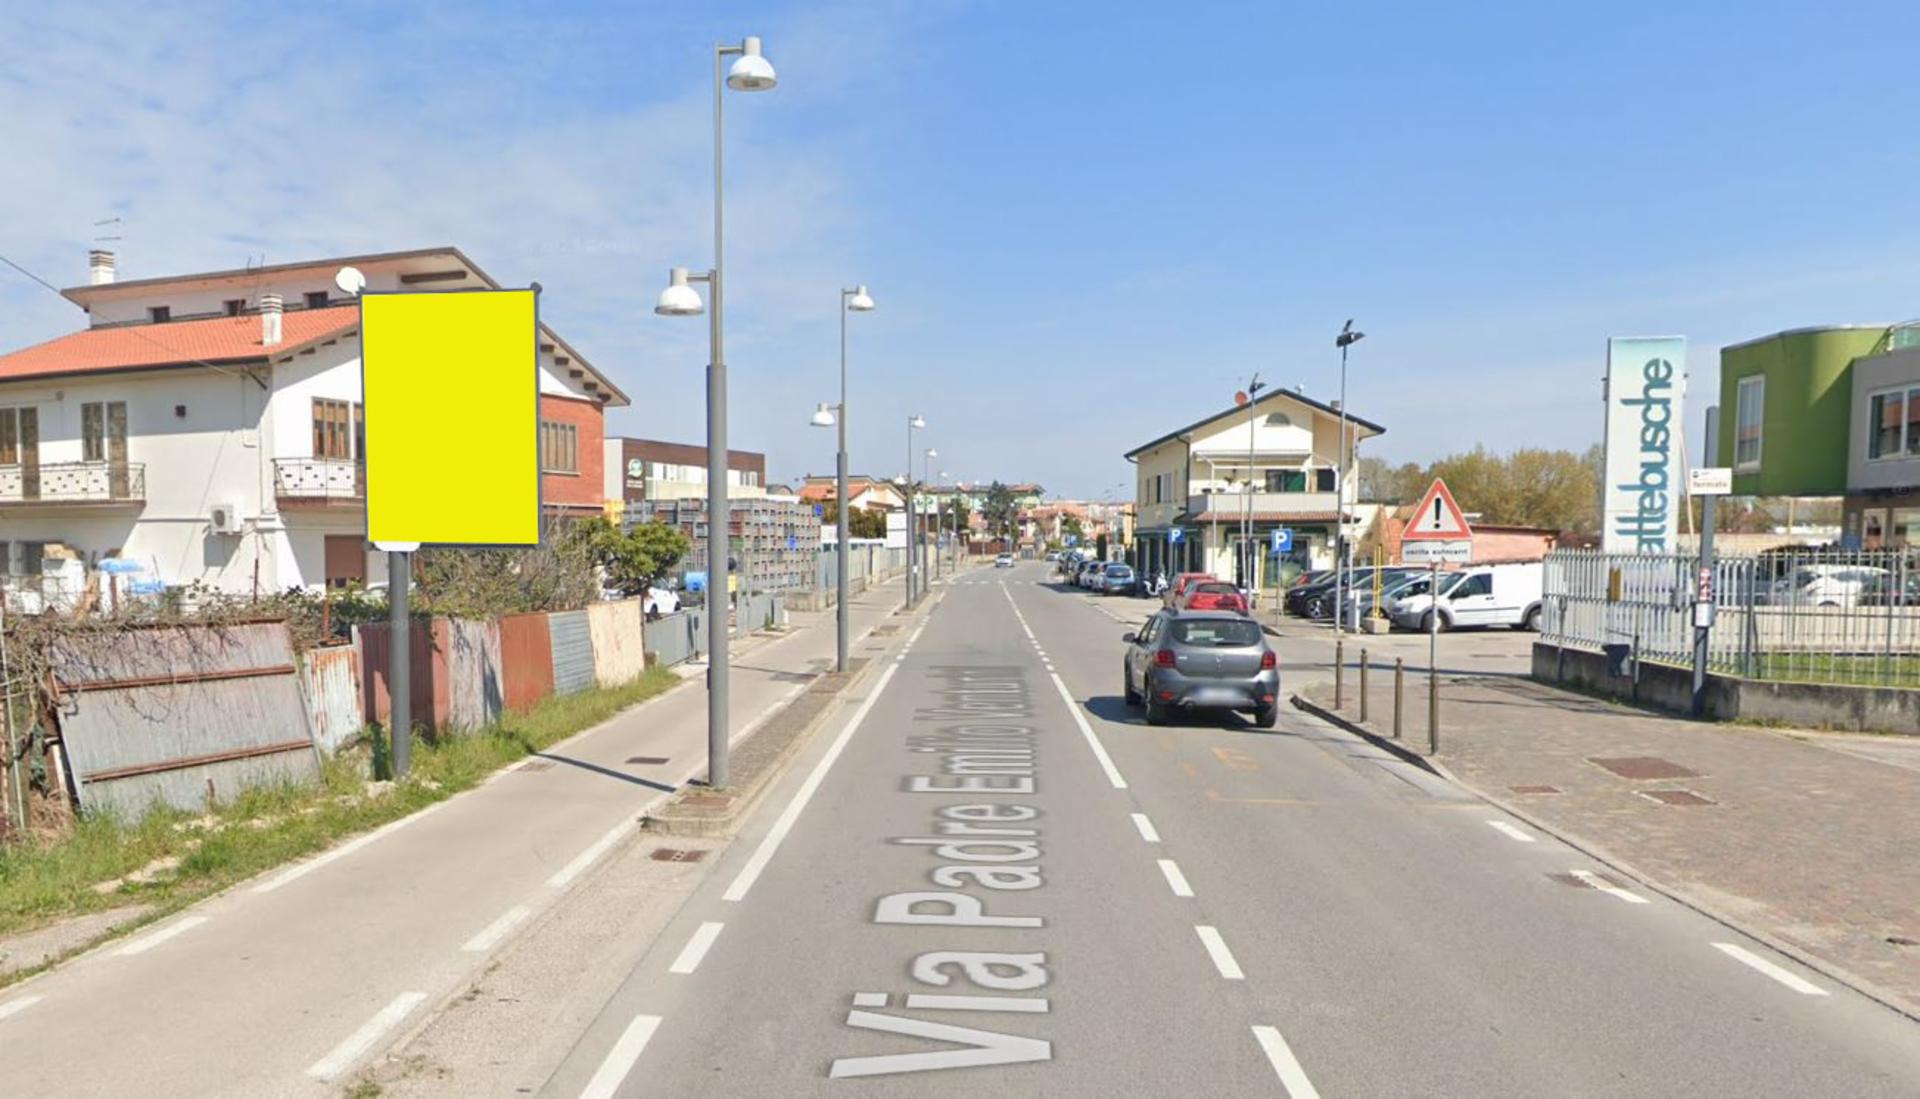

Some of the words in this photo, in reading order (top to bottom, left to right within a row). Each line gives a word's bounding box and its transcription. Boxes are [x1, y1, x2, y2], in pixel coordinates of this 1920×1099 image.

[1615, 357, 1673, 569] attebusche
[1171, 530, 1181, 542] P
[1275, 531, 1288, 549] P
